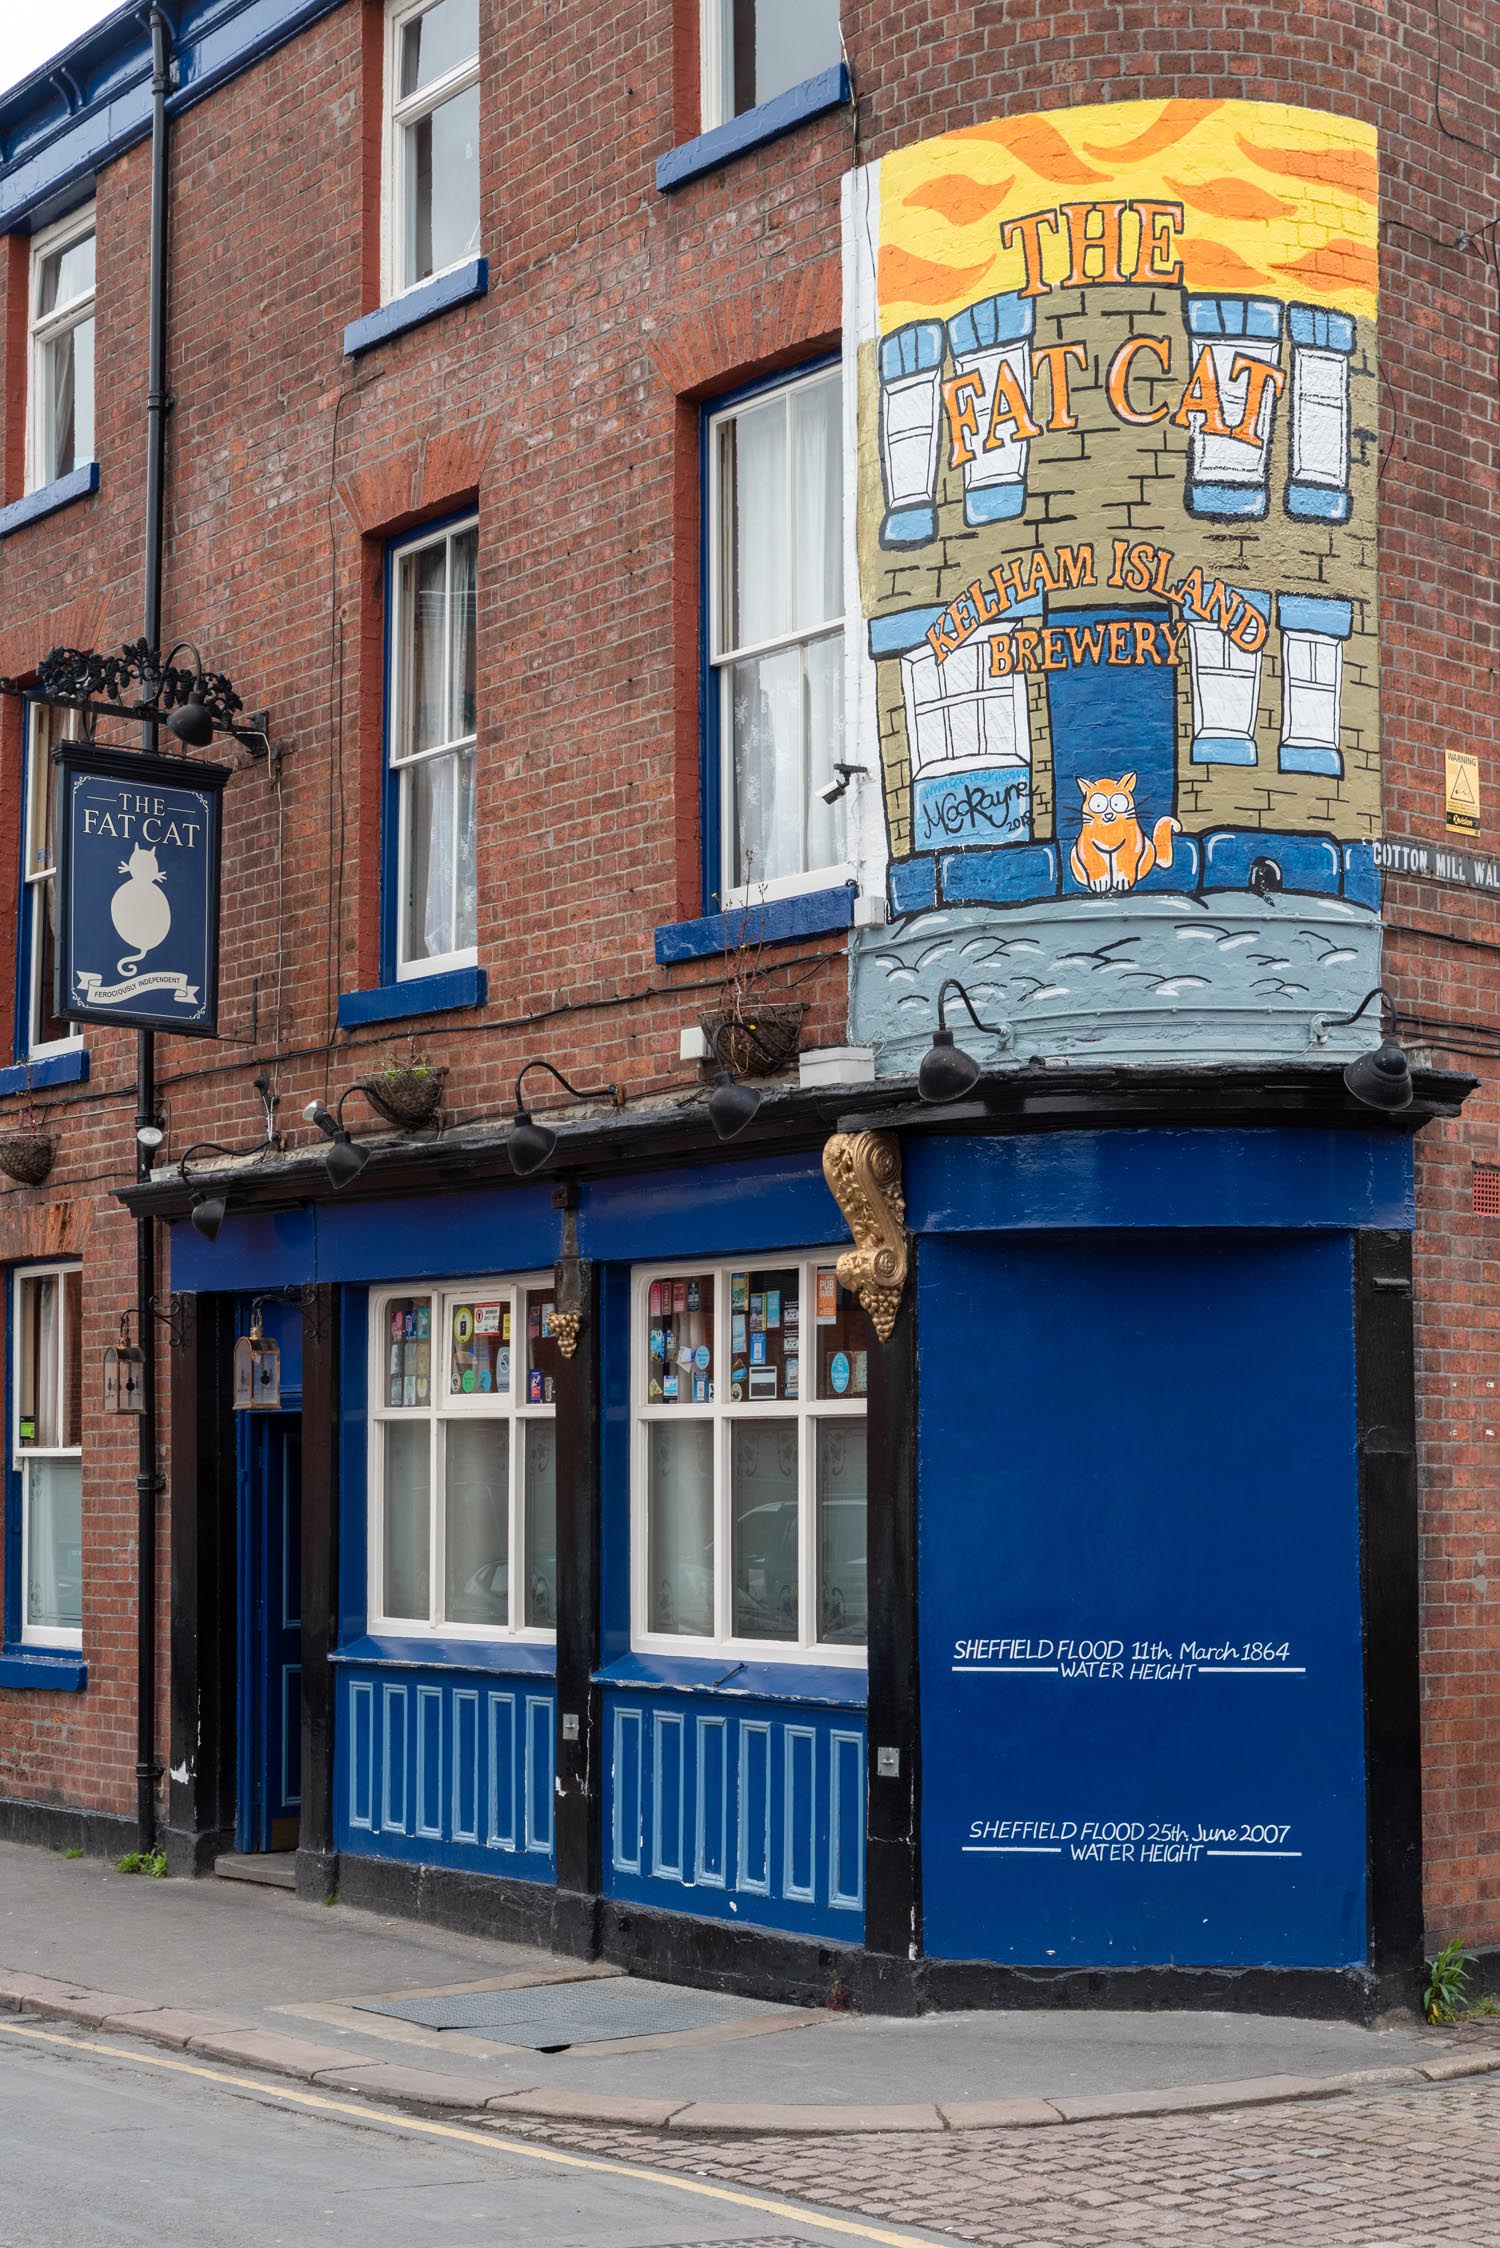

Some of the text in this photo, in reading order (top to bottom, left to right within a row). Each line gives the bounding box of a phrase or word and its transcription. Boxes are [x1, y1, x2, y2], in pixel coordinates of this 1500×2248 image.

[1000, 199, 1184, 298] THE
[941, 335, 1286, 470] FAT CAT
[925, 538, 1271, 665] KELHAM ISLAND
[987, 621, 1187, 677] BREWERY
[1447, 752, 1477, 767] WARNING
[118, 792, 166, 817] THE
[82, 808, 201, 849] FAT CAT
[1373, 842, 1428, 873] COTTON
[1436, 853, 1465, 881] MILL
[94, 976, 181, 998] FEROCIOUSLY INDEPENDENT
[820, 1279, 835, 1290] PUB
[953, 1639, 1054, 1660] SHEFFIELD
[1056, 1640, 1124, 1660] FLOOD
[1180, 1641, 1239, 1661] March
[1240, 1641, 1291, 1662] 1864
[1060, 1662, 1197, 1680] WATER HEIGHT
[969, 1820, 1077, 1841] SHEFFIELD
[1080, 1822, 1145, 1842] FLOOD
[1190, 1824, 1239, 1842] June
[1240, 1824, 1291, 1844] 2007
[1070, 1843, 1205, 1863] WATER HEIGHT
